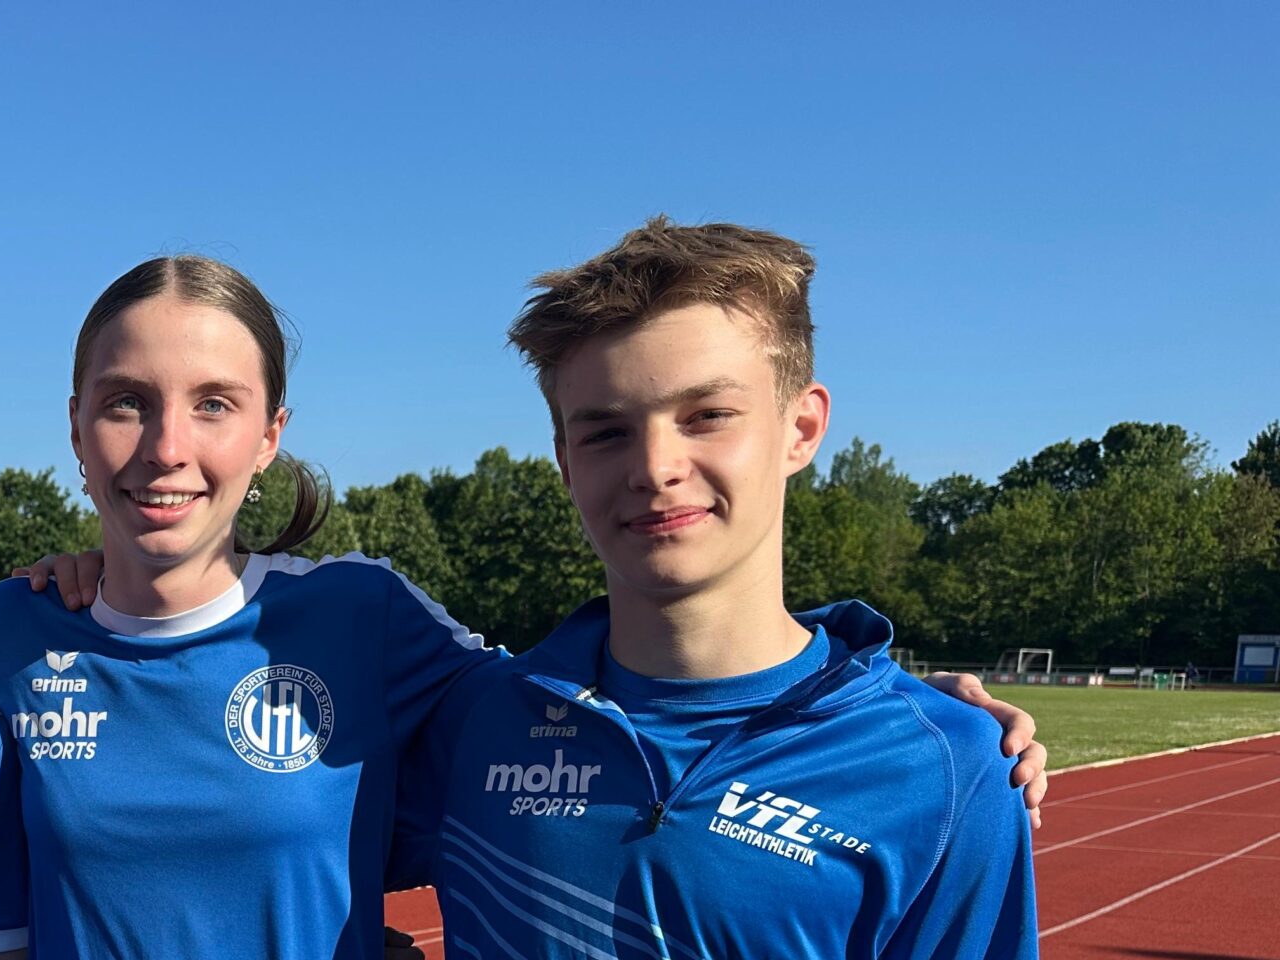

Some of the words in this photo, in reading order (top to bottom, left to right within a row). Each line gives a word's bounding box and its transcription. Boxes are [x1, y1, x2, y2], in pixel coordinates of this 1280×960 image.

[31, 675, 87, 693] erima
[229, 704, 239, 728] DER
[234, 667, 304, 703] SPORTVEREIN
[303, 674, 323, 694] FÜR
[319, 694, 331, 731] STADE
[11, 697, 108, 739] mohr
[529, 724, 578, 738] erima
[30, 742, 97, 760] SPORTS
[234, 738, 249, 753] 175
[246, 752, 275, 769] Jahre
[484, 749, 602, 793] mohr
[509, 796, 588, 818] SPORTS
[716, 781, 822, 844] VfL
[808, 822, 872, 855] STADE
[708, 816, 818, 867] LEICHTATHLETIK
